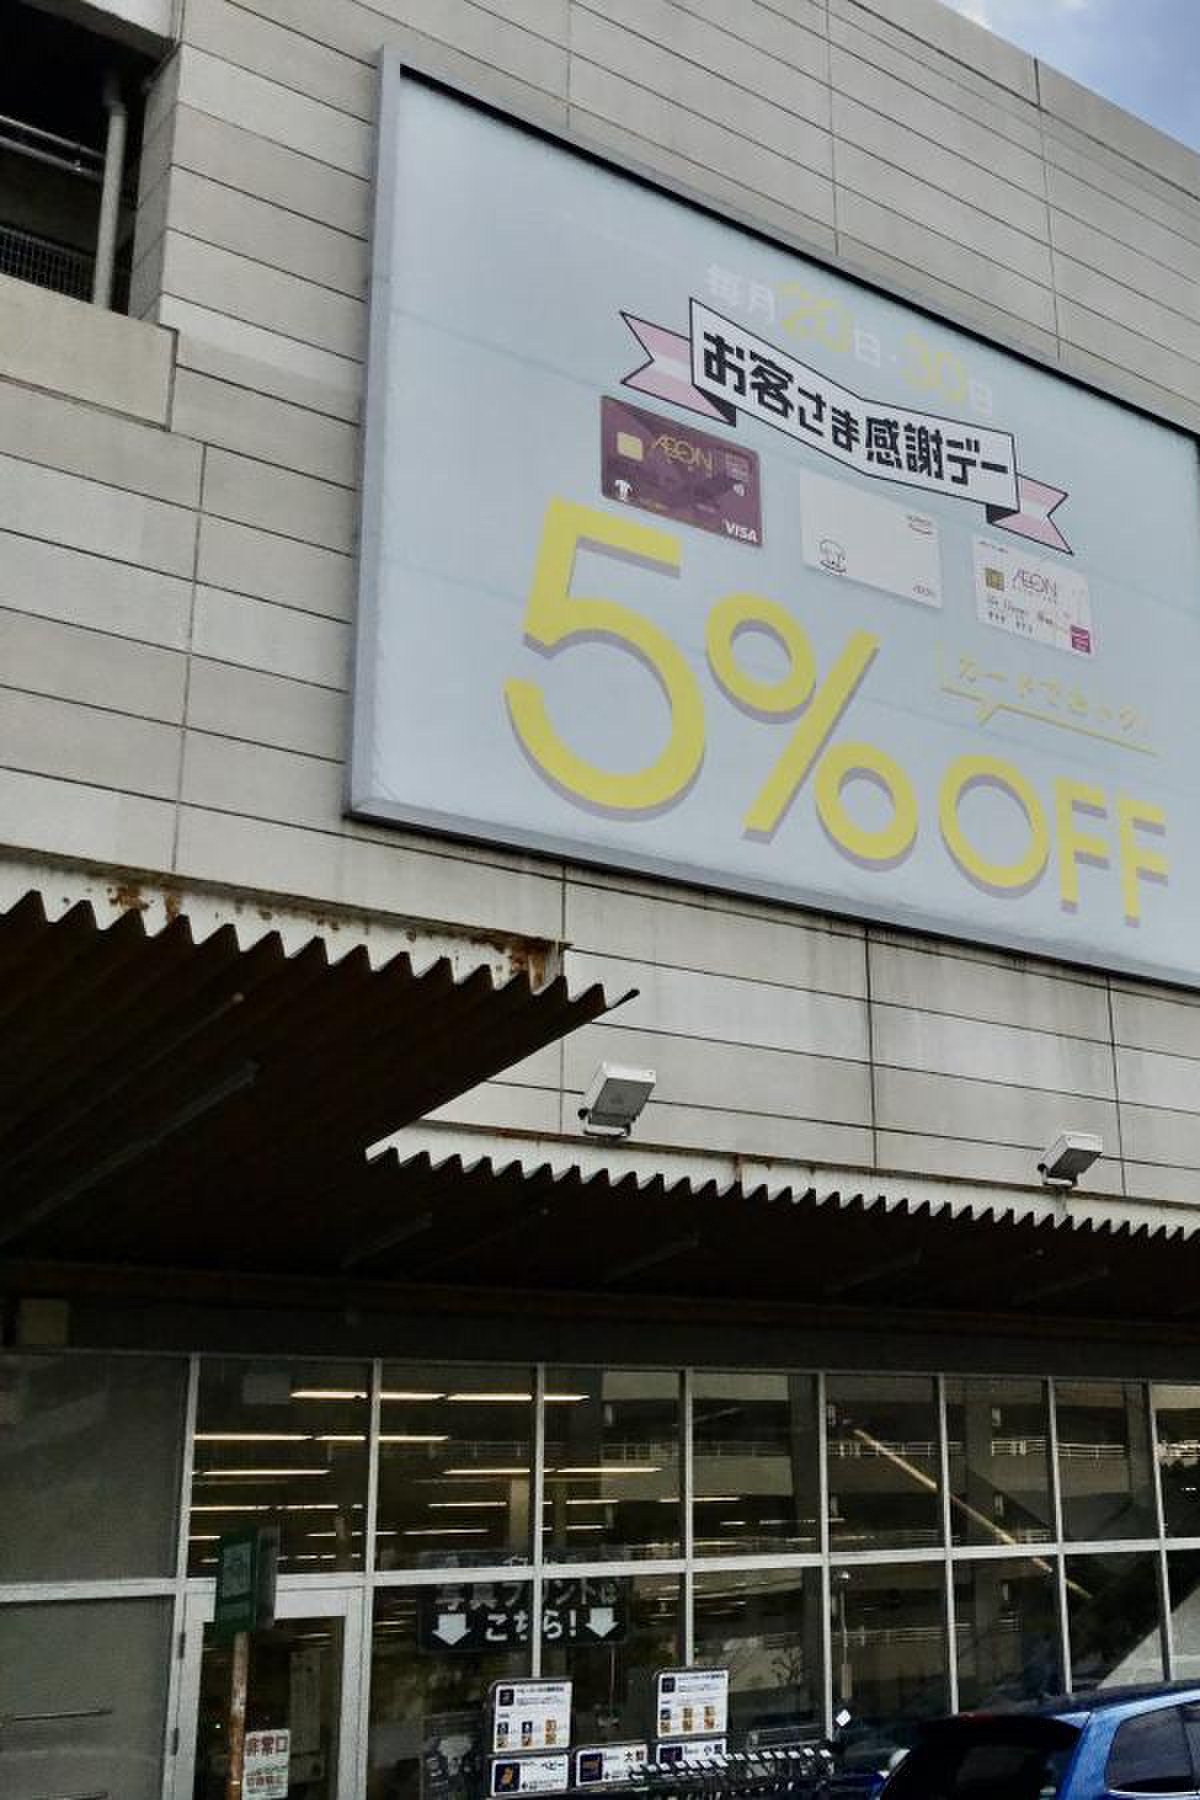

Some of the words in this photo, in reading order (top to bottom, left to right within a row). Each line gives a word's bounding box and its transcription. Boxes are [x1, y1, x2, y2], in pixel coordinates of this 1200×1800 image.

[702, 331, 1010, 488] お客さま感謝デー
[722, 520, 758, 543] VISA
[245, 1735, 289, 1757] 非常口
